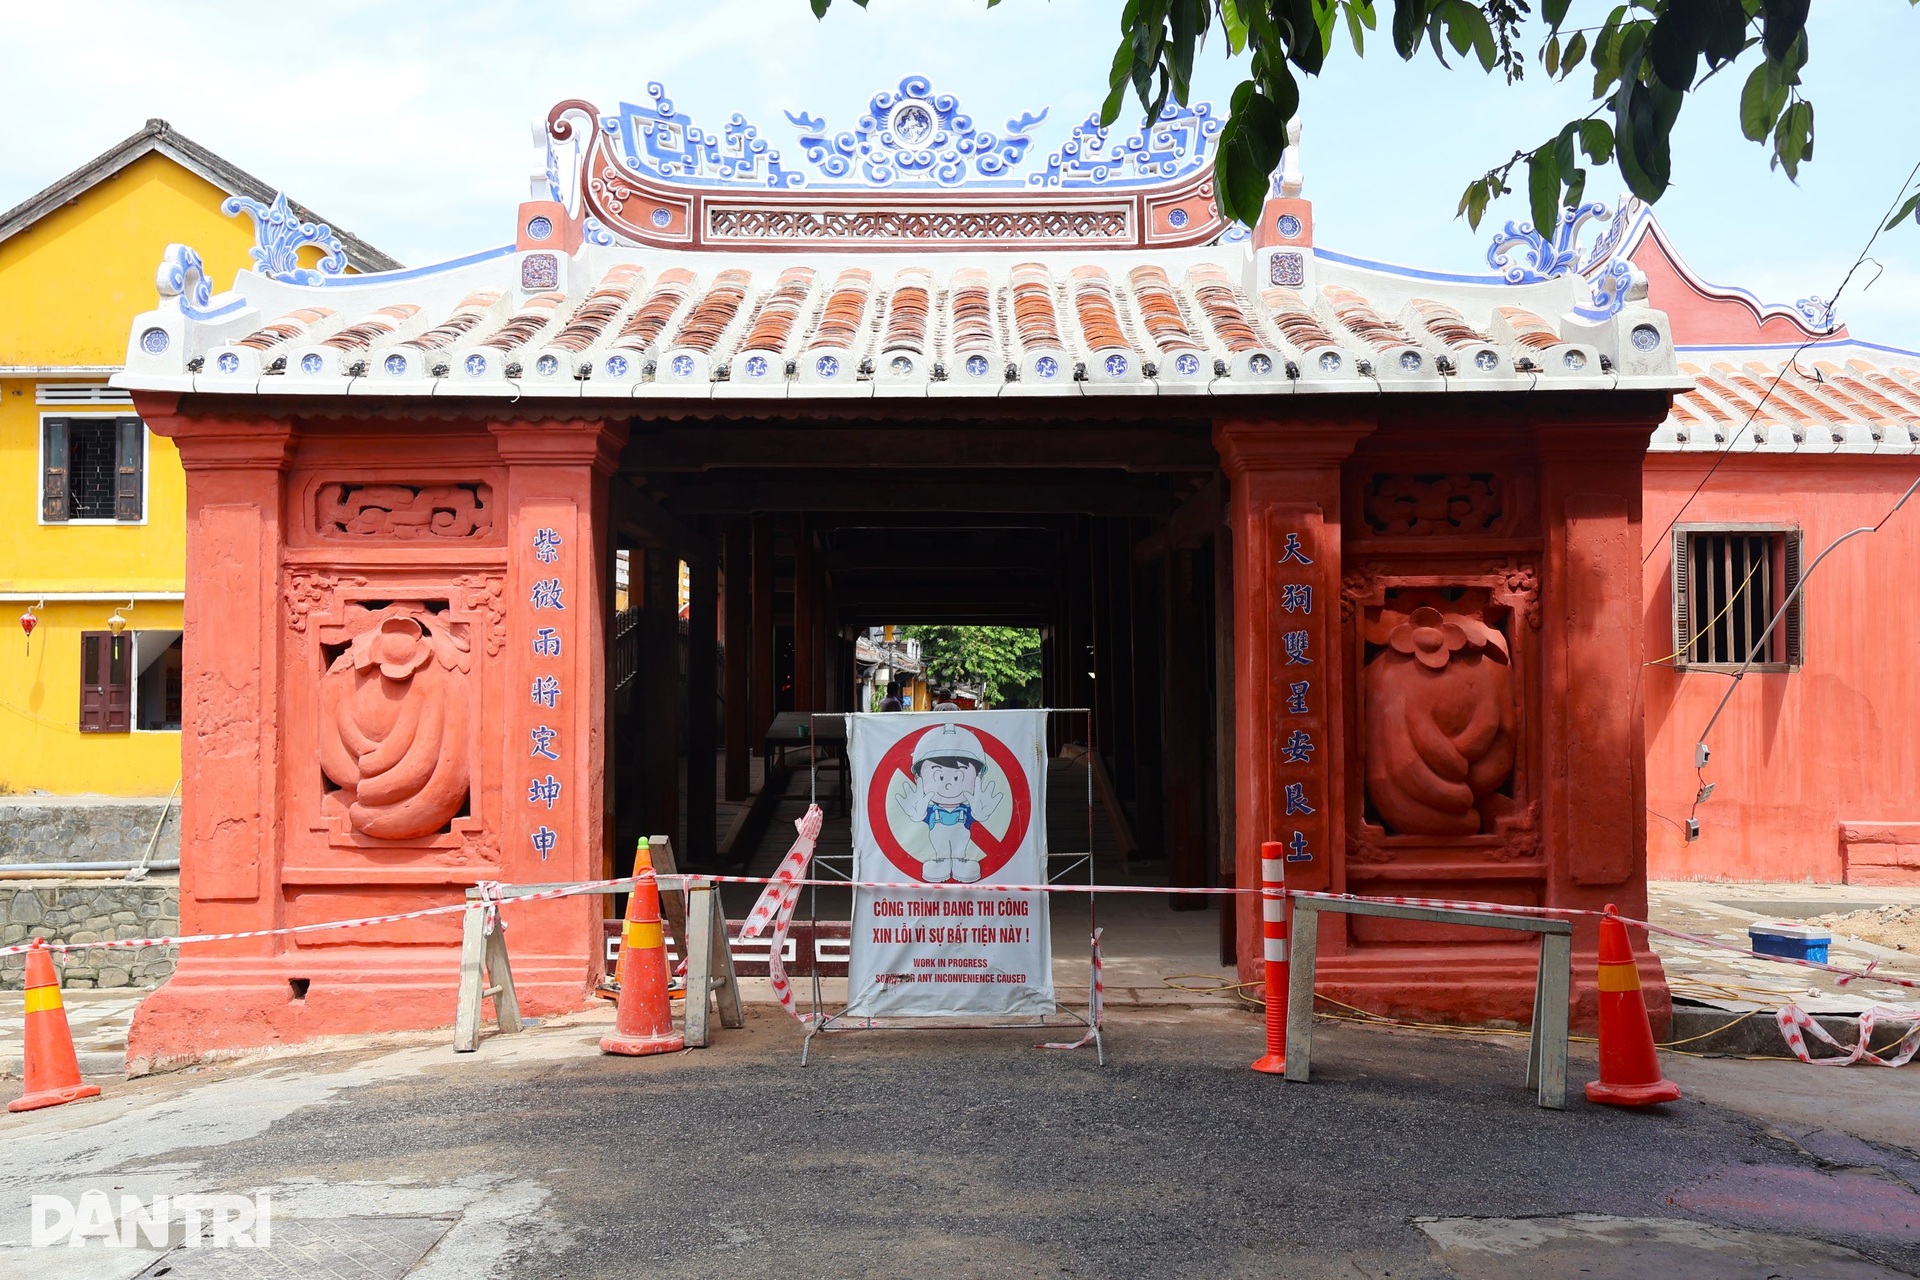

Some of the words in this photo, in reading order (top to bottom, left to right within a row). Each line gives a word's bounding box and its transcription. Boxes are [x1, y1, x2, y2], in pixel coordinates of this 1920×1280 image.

[873, 897, 904, 917] CÔNG
[907, 897, 940, 917] TRÌNH
[943, 900, 974, 917] ĐANG
[977, 900, 994, 917] THI
[997, 897, 1029, 917] CÔNG
[872, 927, 892, 944] XIN
[895, 922, 912, 944] LỖI
[915, 924, 926, 943] VÌ
[929, 926, 946, 947] SỰ
[947, 922, 969, 944] BẤT
[971, 924, 997, 947] TIỆN
[999, 924, 1022, 944] NÀY
[1025, 927, 1030, 943] !
[913, 958, 936, 968] WORK
[937, 958, 946, 968] IN
[948, 958, 988, 969] PROGRESS
[917, 974, 933, 983] ANY
[935, 974, 995, 983] INCONVENIENCE
[997, 974, 1026, 983] CAUSED
